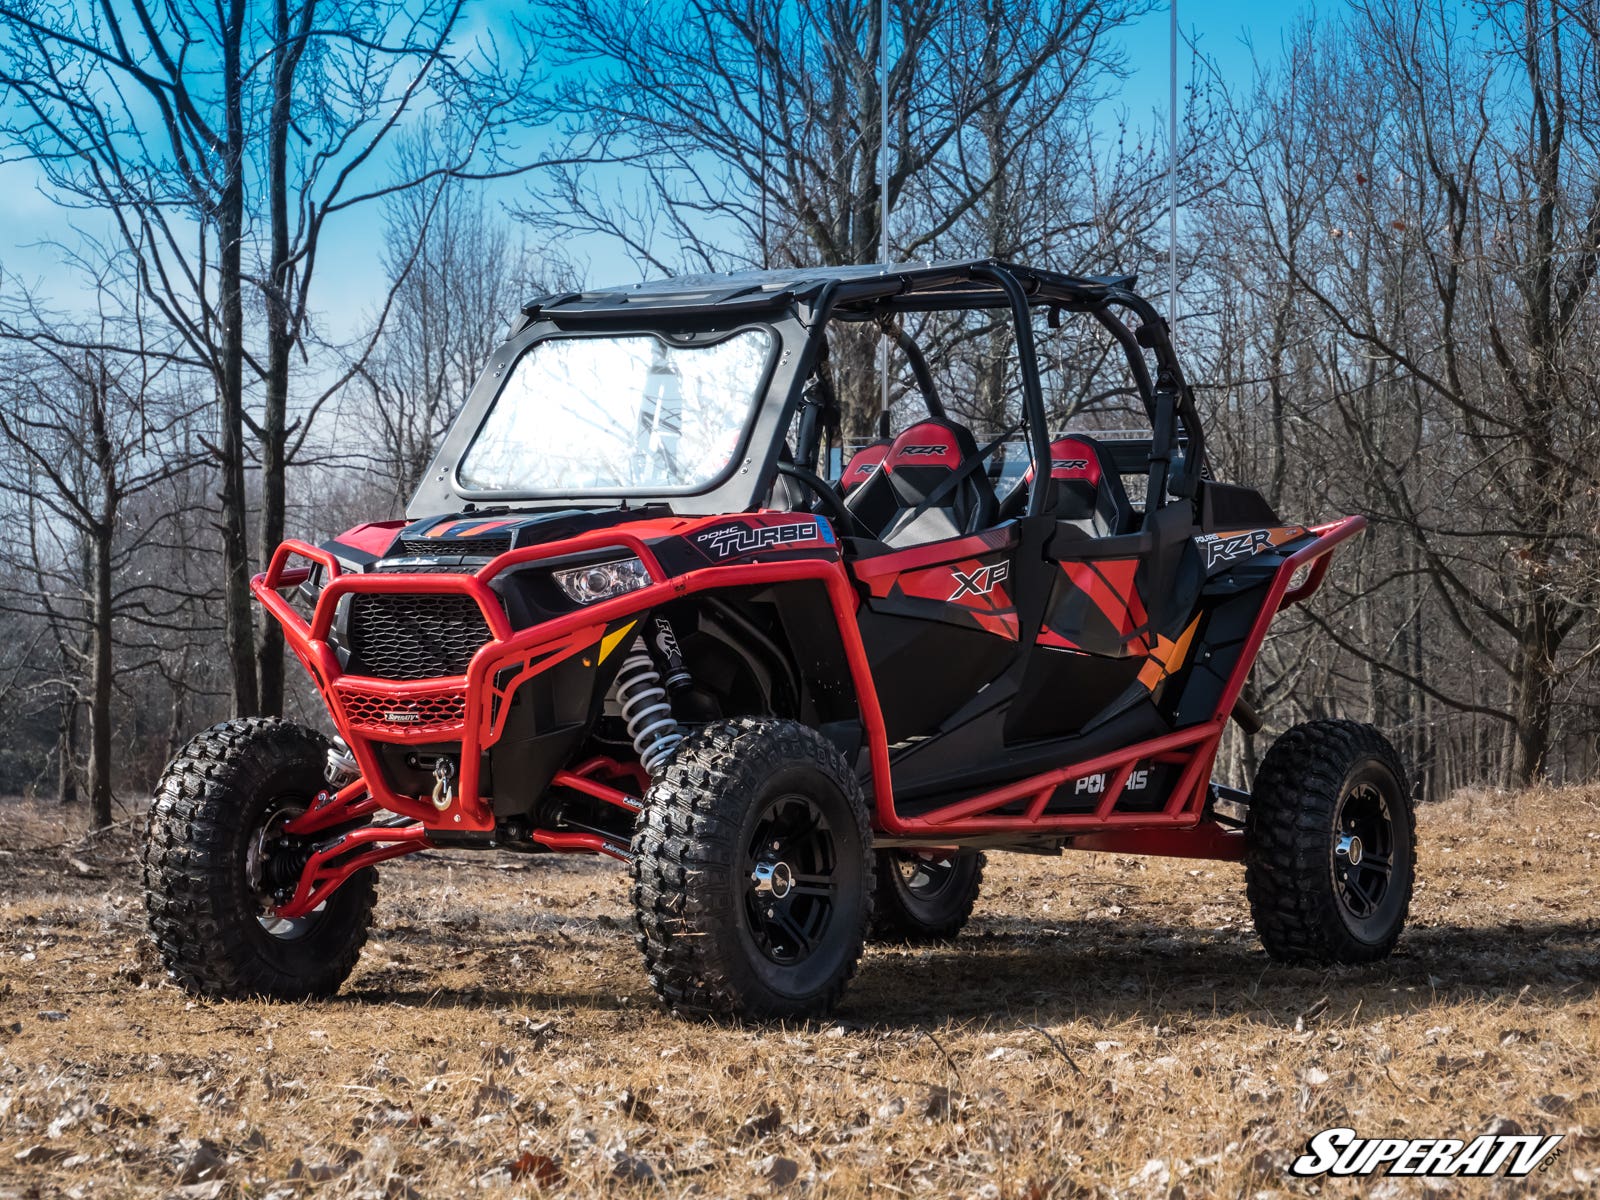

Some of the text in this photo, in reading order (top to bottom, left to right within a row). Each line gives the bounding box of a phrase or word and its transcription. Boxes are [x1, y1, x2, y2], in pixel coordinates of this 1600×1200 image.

[898, 445, 949, 457] RZR
[1051, 459, 1089, 470] ZR
[697, 526, 739, 542] DOHC
[709, 522, 818, 557] TURBO
[1194, 533, 1220, 544] POLARIS
[1207, 528, 1277, 569] RZR
[946, 559, 1010, 602] XP
